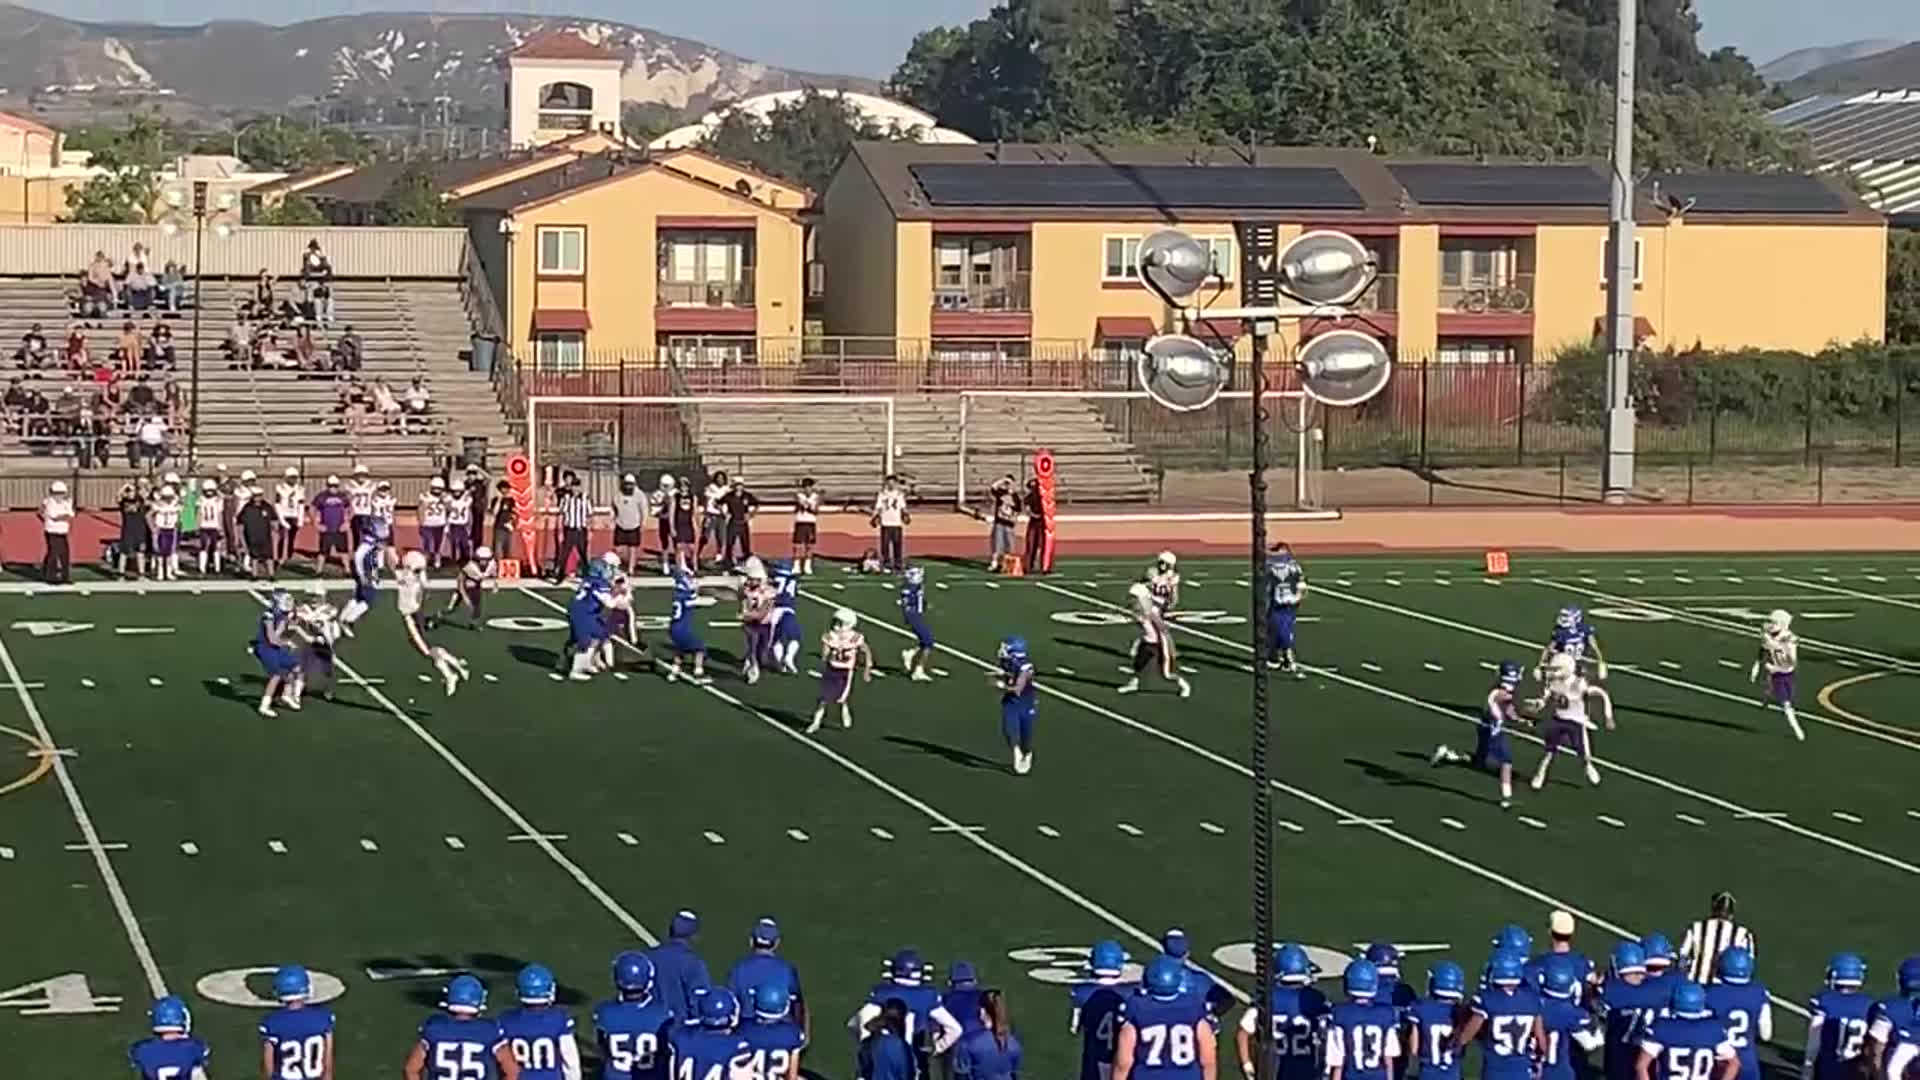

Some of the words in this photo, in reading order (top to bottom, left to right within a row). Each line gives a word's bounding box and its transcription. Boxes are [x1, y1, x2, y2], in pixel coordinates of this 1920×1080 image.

[1140, 1023, 1194, 1066] 78
[1268, 1014, 1311, 1057] 52
[1352, 1023, 1382, 1069] 13
[1491, 1015, 1534, 1057] 57
[1727, 1010, 1749, 1047] 2
[1835, 1017, 1868, 1060] 12
[279, 1034, 323, 1080] 20
[433, 1041, 486, 1080] 55
[1668, 1047, 1715, 1080] 50
